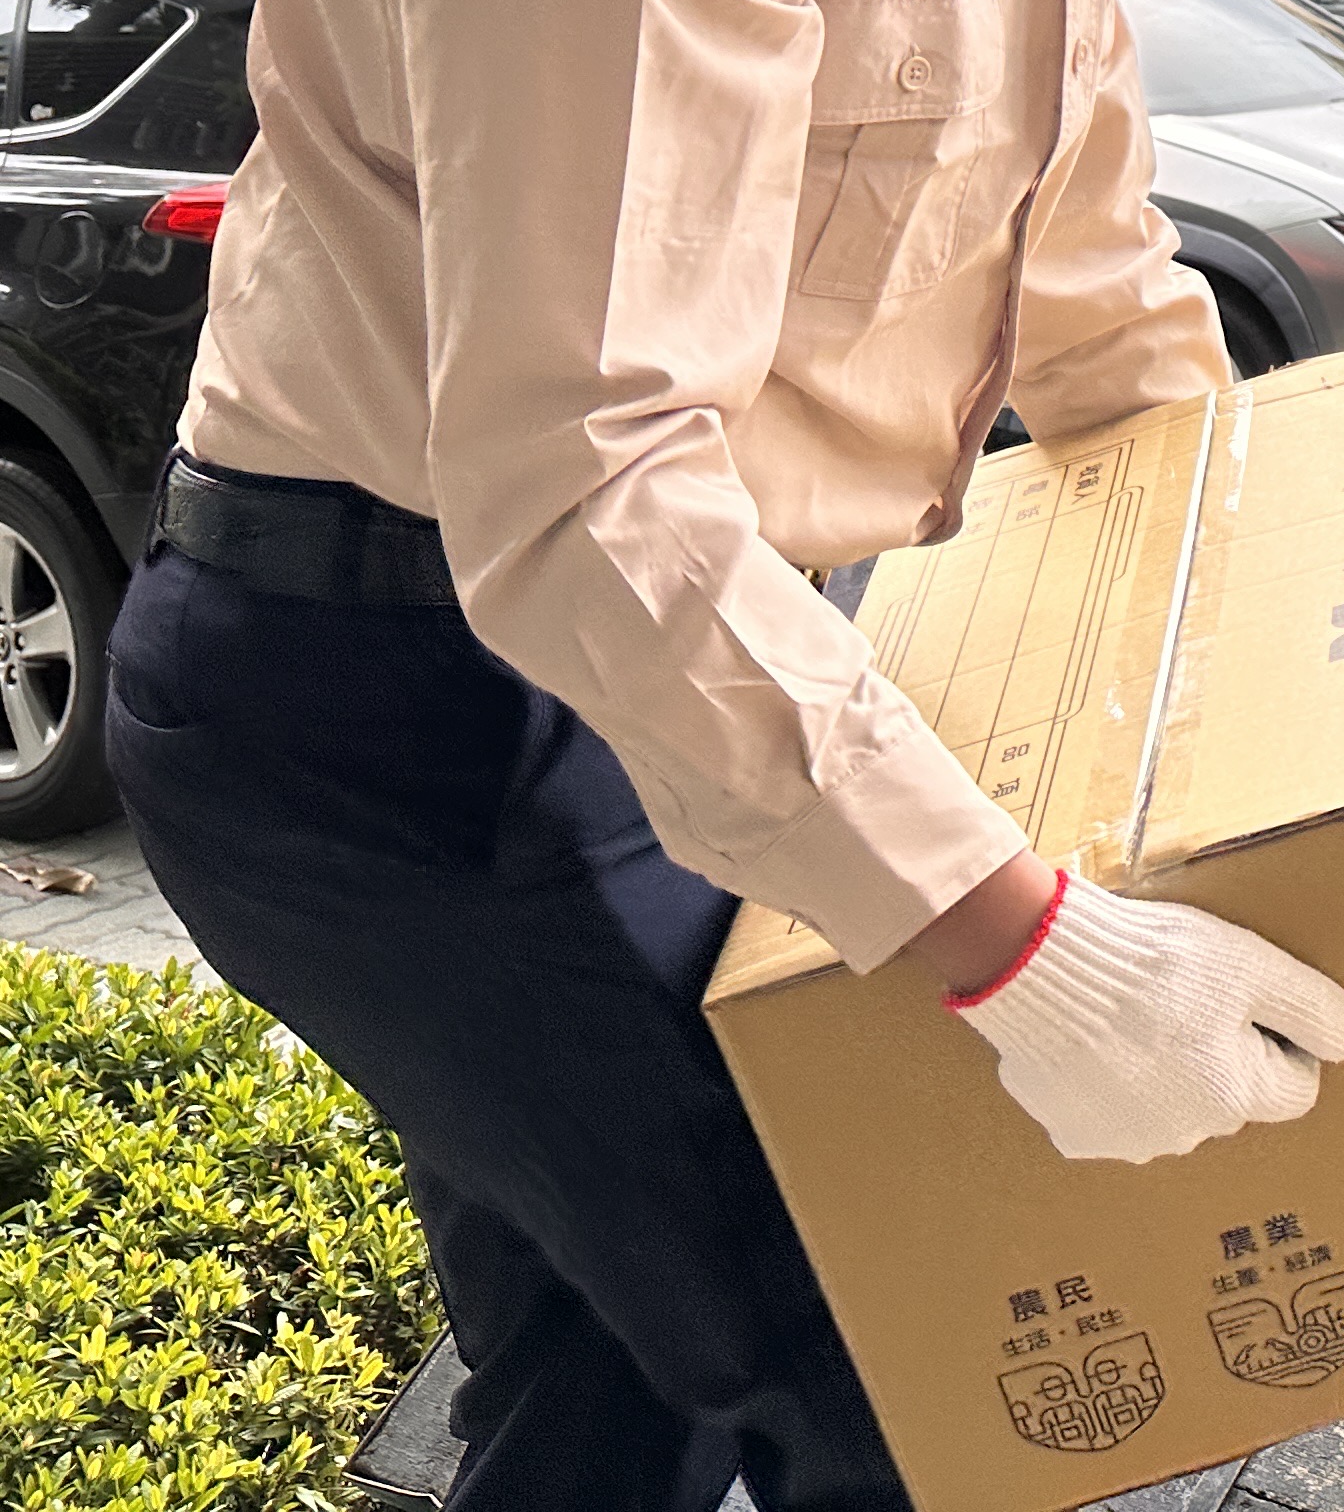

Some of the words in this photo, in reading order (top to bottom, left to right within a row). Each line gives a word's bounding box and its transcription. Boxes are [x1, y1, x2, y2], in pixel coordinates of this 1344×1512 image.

[991, 742, 1030, 801] 品項
[1220, 1213, 1303, 1260] 農業
[1009, 1275, 1093, 1322] 農民
